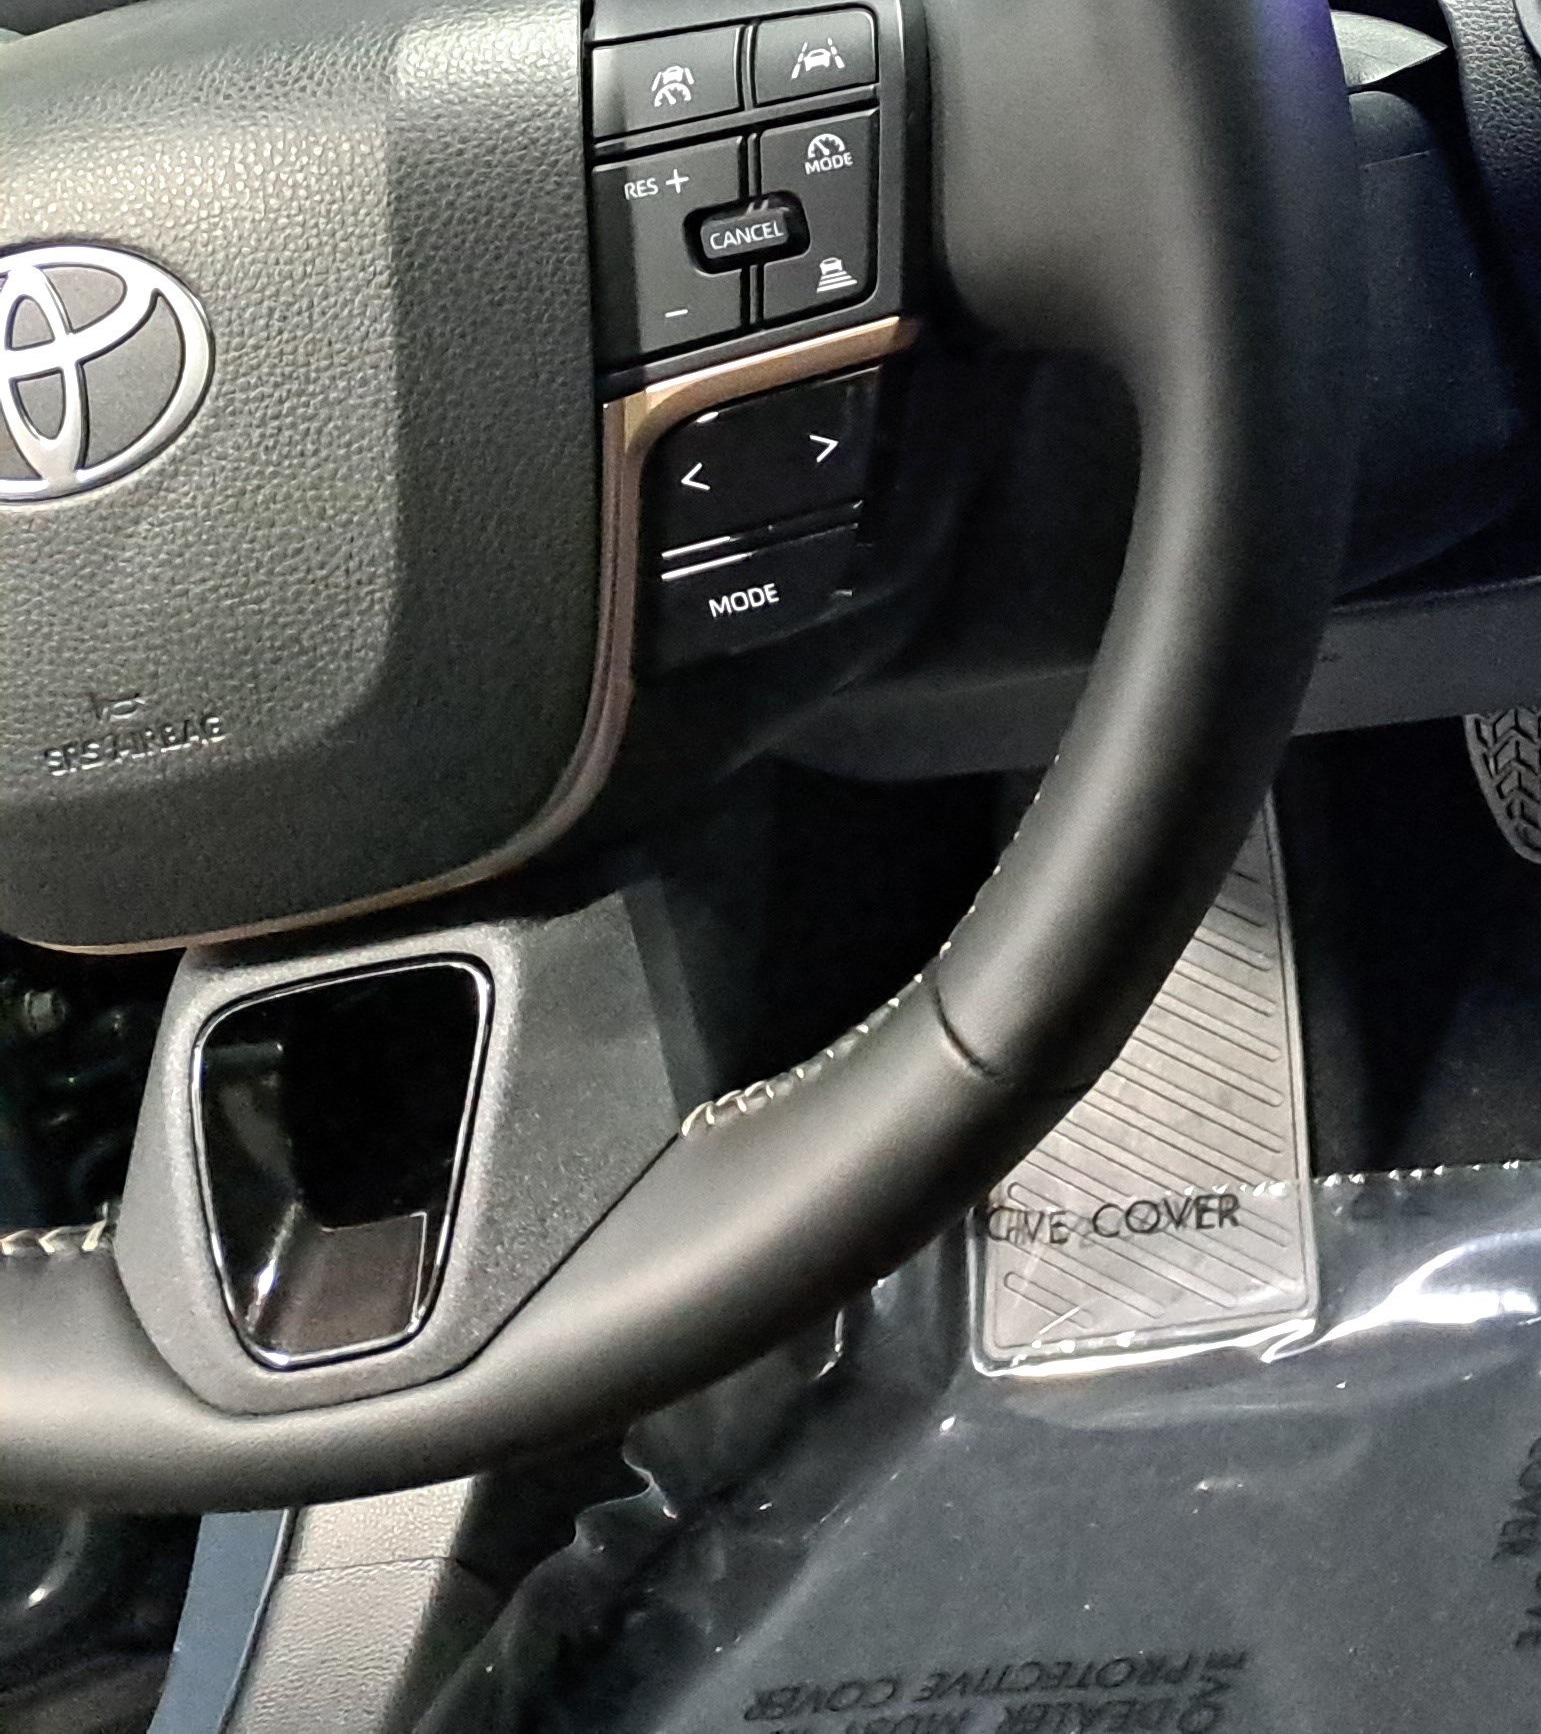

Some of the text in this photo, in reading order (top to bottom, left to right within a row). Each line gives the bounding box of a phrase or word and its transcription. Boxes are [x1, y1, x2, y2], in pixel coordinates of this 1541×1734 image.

[804, 151, 854, 175] MODE
[623, 176, 659, 201] RES
[709, 220, 784, 251] CANCEL
[708, 583, 780, 618] MODE
[1091, 1192, 1240, 1238] COVER
[911, 1649, 1199, 1704] PROTECTIVE
